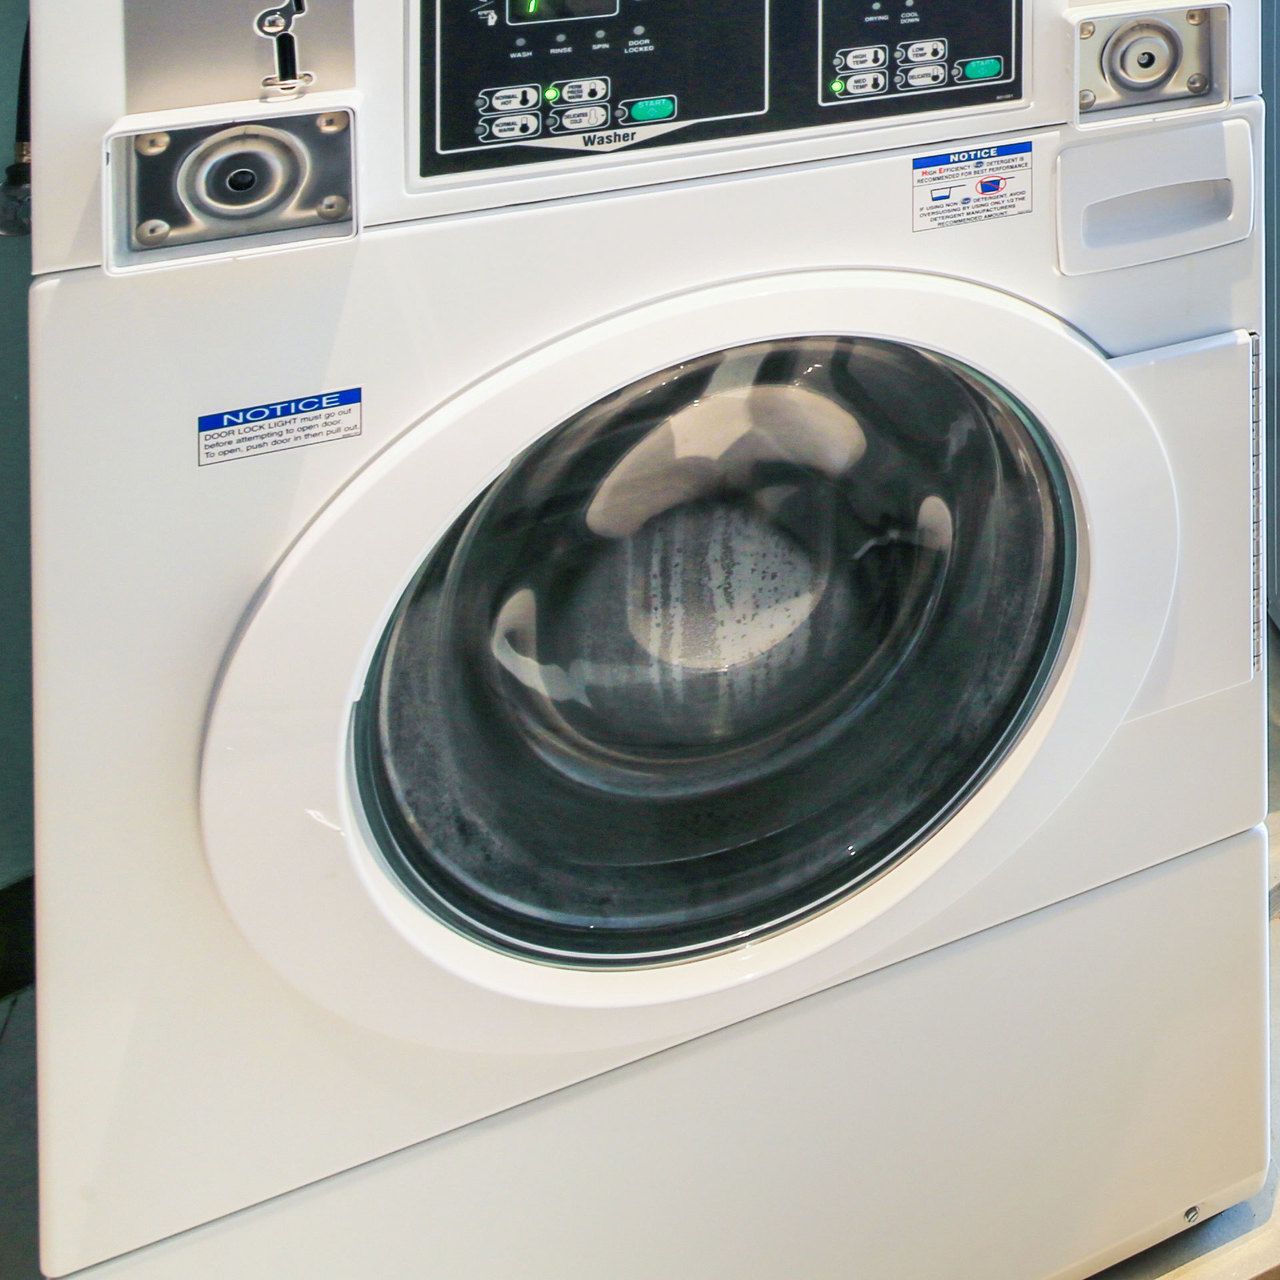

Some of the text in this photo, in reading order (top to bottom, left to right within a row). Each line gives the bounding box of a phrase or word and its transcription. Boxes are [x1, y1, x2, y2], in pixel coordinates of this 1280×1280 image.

[509, 51, 533, 59] WASH
[550, 47, 573, 55] RINSE
[624, 45, 655, 54] LOCKED
[638, 99, 666, 108] START
[583, 130, 636, 147] Washer
[950, 148, 998, 162] NOTICE
[917, 173, 959, 184] RECOMMENDED
[989, 163, 1028, 173] PERFORMANCE
[939, 165, 971, 175] EFFICIENCY
[986, 158, 1018, 166] DETERGENT
[223, 393, 341, 426] NOTICE
[204, 408, 351, 442] DOOR LOCK LIGHT must go out
[204, 418, 342, 450] before attempting to open door.
[204, 450, 216, 459] To
[246, 441, 269, 452] push
[270, 436, 292, 446] door
[293, 434, 302, 442] in
[303, 430, 324, 440] then
[325, 426, 341, 436] pull
[342, 424, 360, 433] out.
